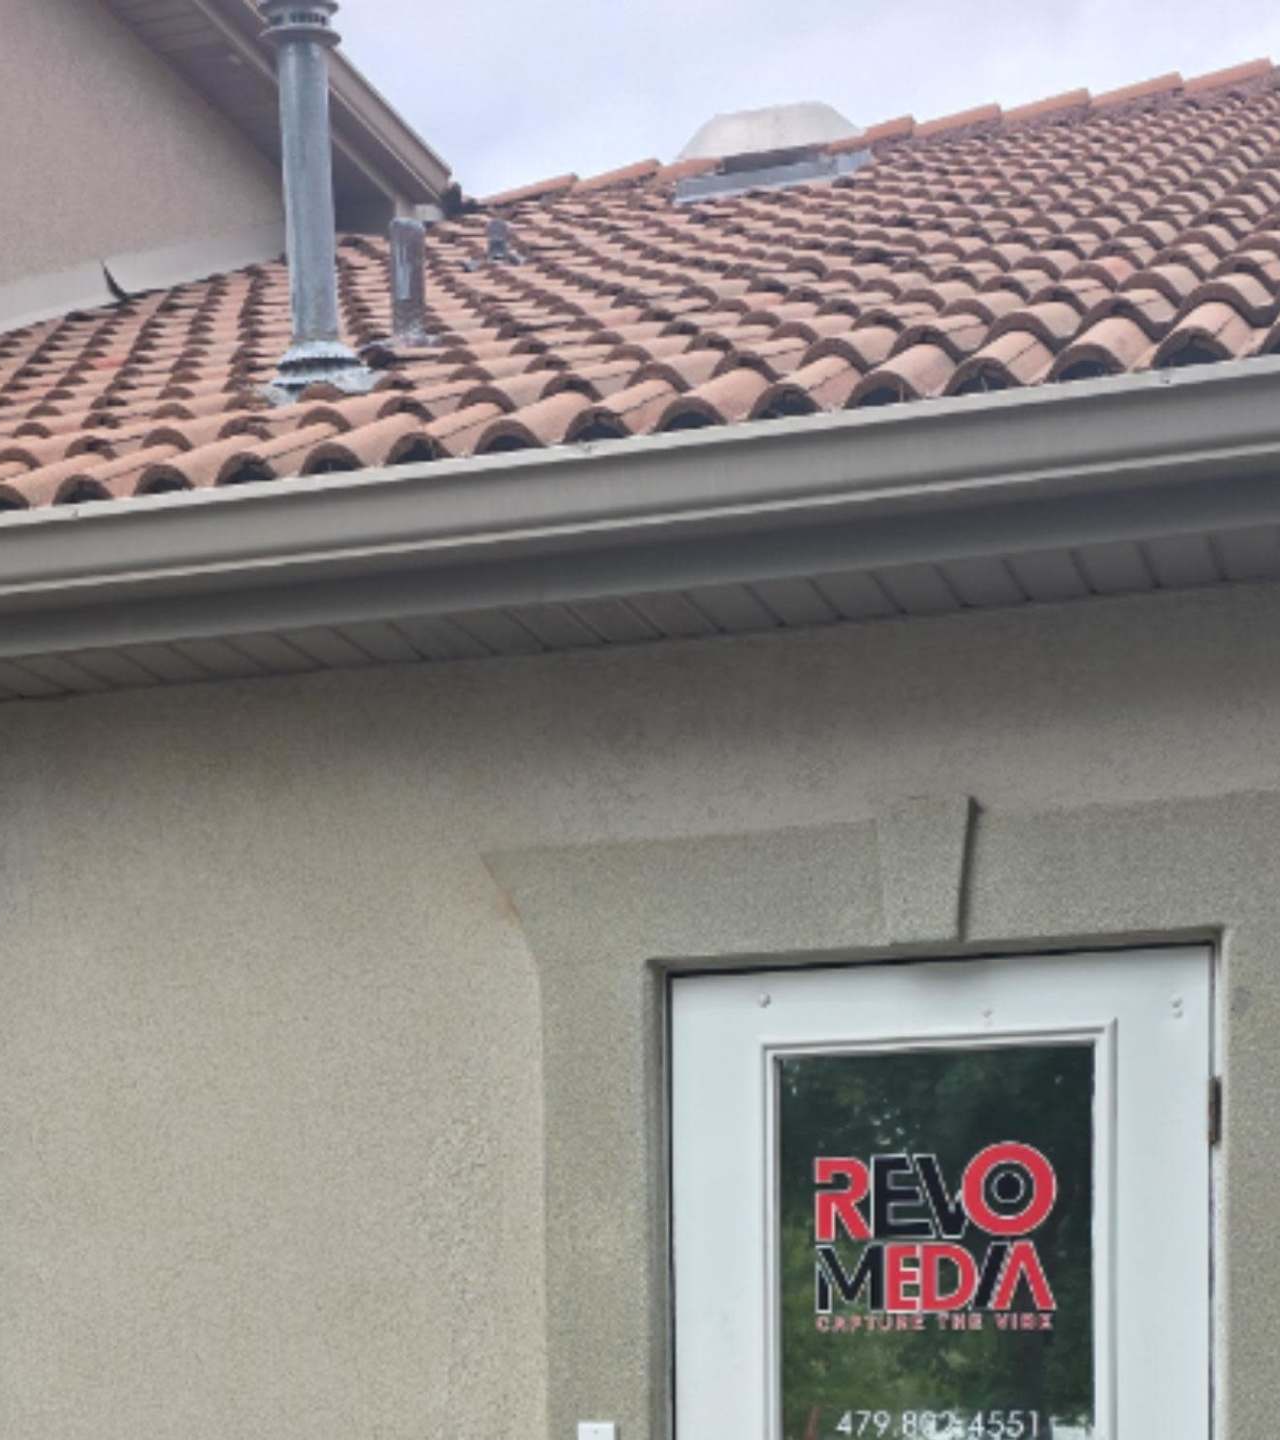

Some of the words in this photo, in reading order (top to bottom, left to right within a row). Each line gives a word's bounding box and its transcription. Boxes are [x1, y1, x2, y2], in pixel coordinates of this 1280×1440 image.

[815, 1141, 1058, 1242] REVO
[816, 1313, 926, 1332] CAPTURE
[937, 1312, 983, 1331] THE
